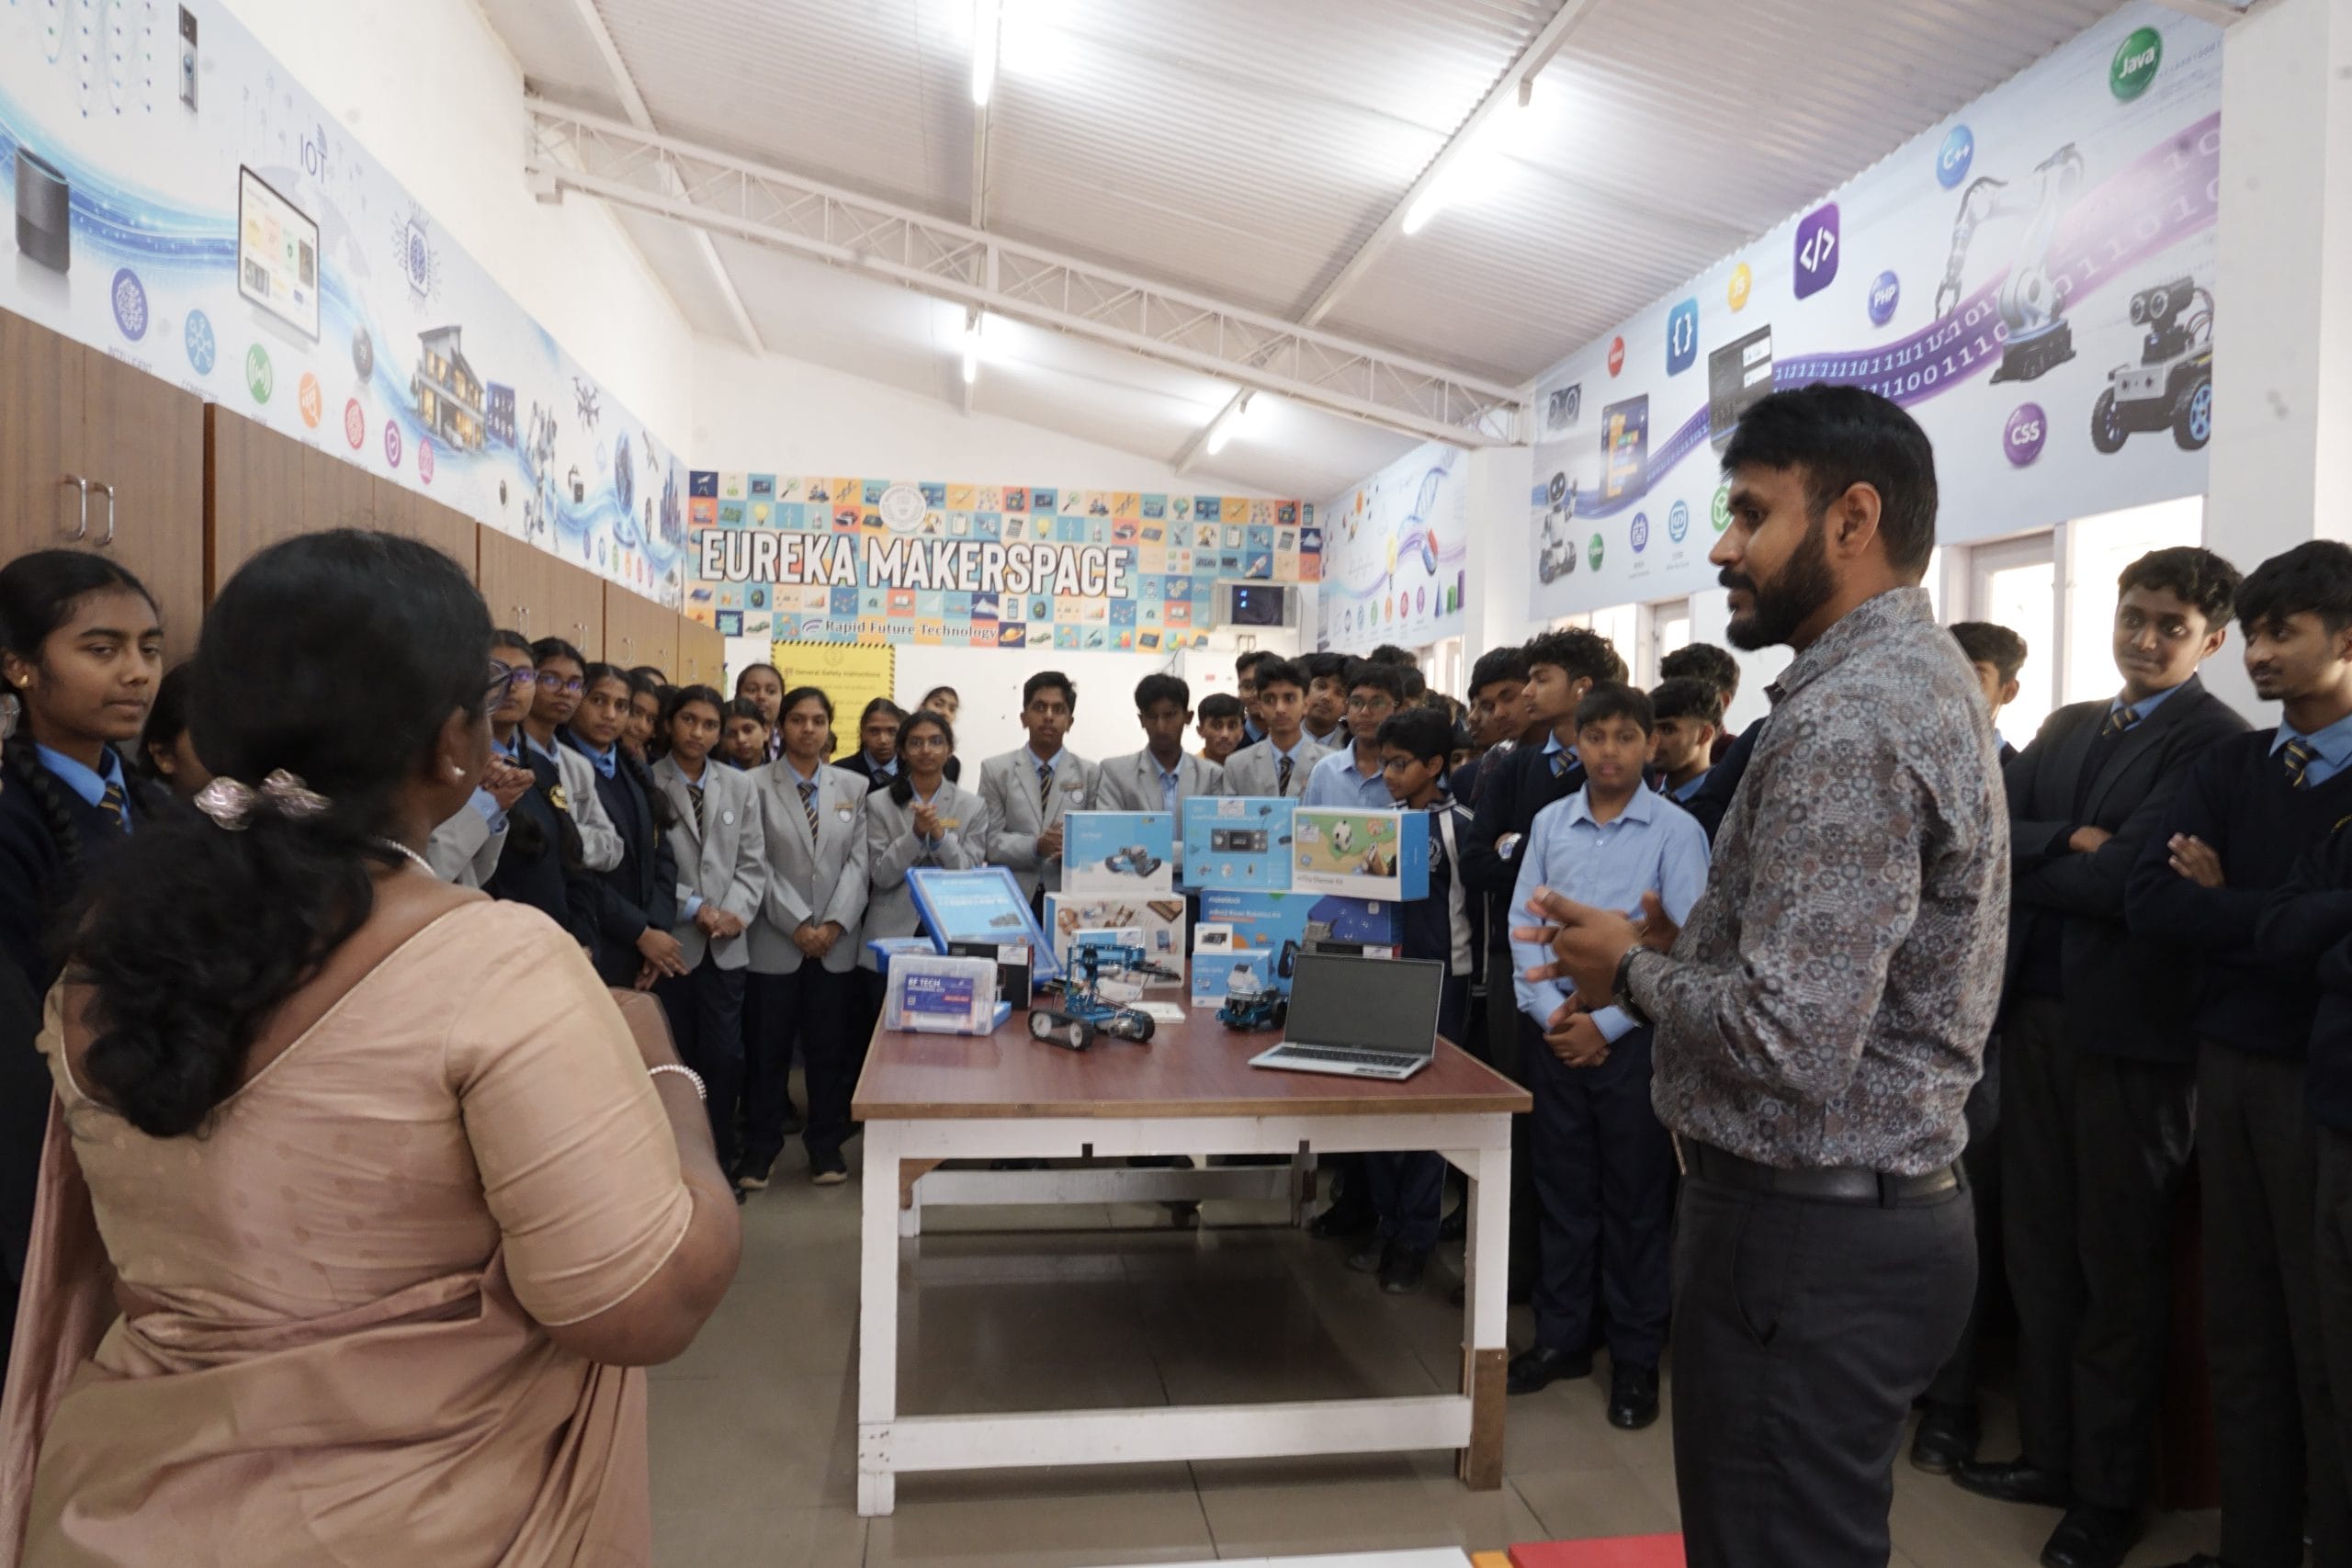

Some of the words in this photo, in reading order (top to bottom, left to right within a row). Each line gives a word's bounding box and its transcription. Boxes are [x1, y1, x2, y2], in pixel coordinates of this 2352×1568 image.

[2119, 46, 2155, 79] Java
[1943, 144, 1970, 170] C++
[1873, 283, 1896, 309] PHP
[2011, 419, 2041, 446] CSS
[700, 528, 857, 587] EUREKA
[866, 536, 1133, 597] MAKERSPACE
[826, 620, 865, 634] Rapid
[870, 621, 915, 635] Future
[920, 623, 997, 639] Technology
[920, 977, 941, 988] TECH
